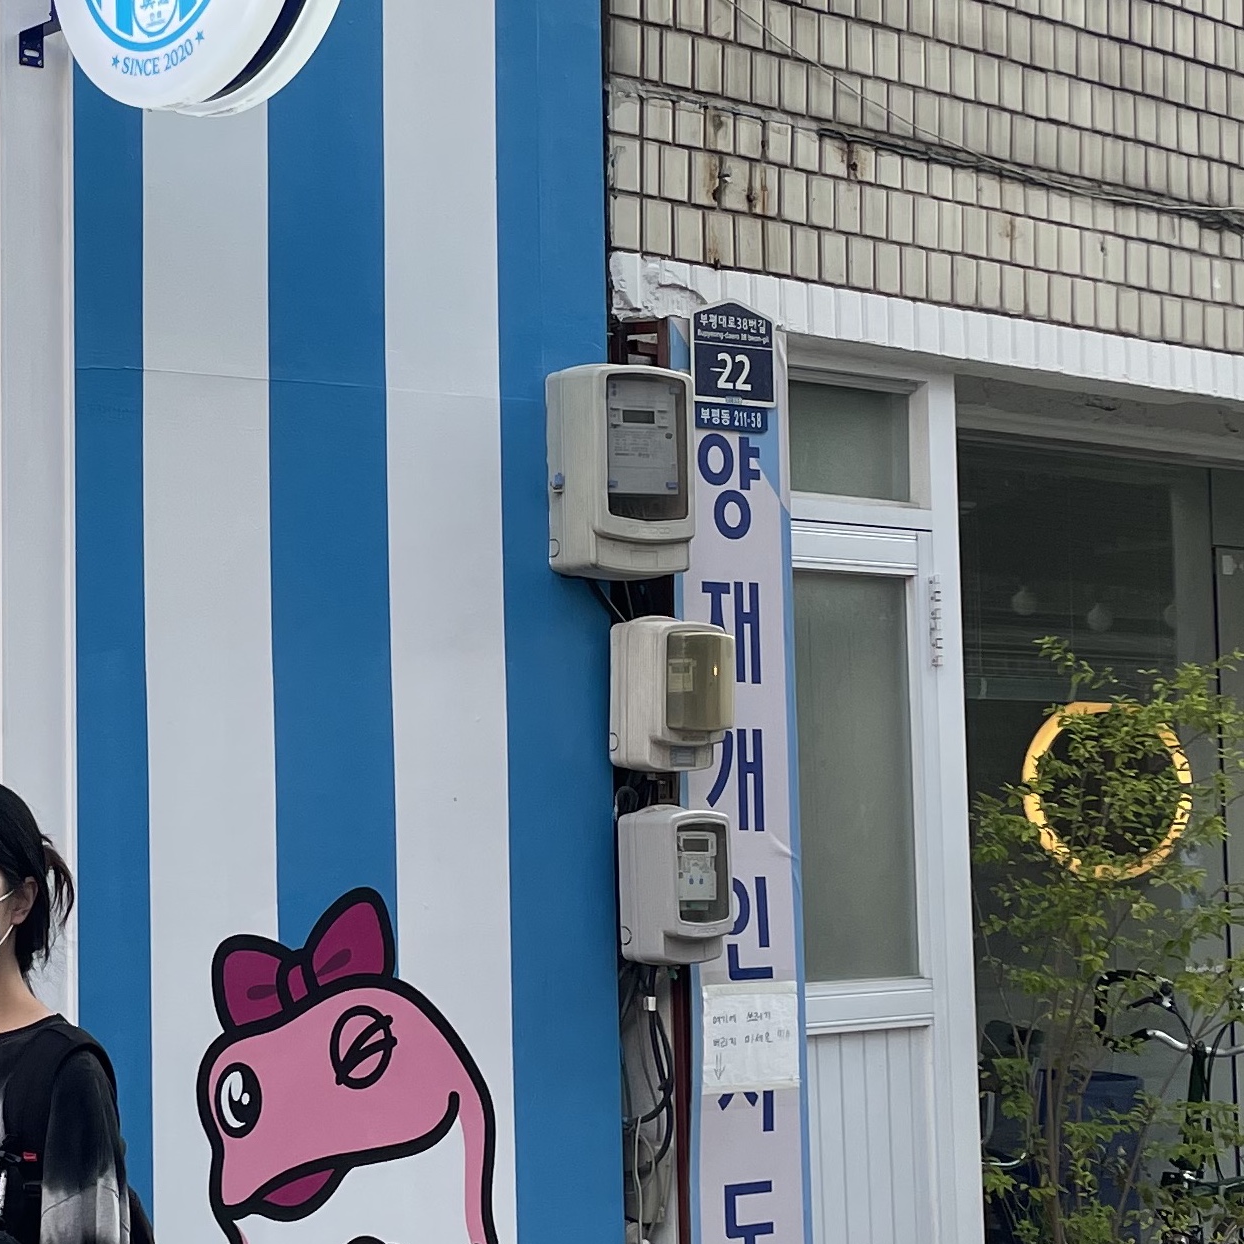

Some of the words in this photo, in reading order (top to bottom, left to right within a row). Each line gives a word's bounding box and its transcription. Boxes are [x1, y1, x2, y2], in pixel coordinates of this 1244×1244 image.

[121, 56, 160, 76] SINCE
[163, 38, 194, 71] 2020
[699, 312, 767, 335] 부평대로38번길
[716, 352, 752, 392] 22
[700, 407, 731, 426] 부평동
[733, 410, 762, 429] 211-58
